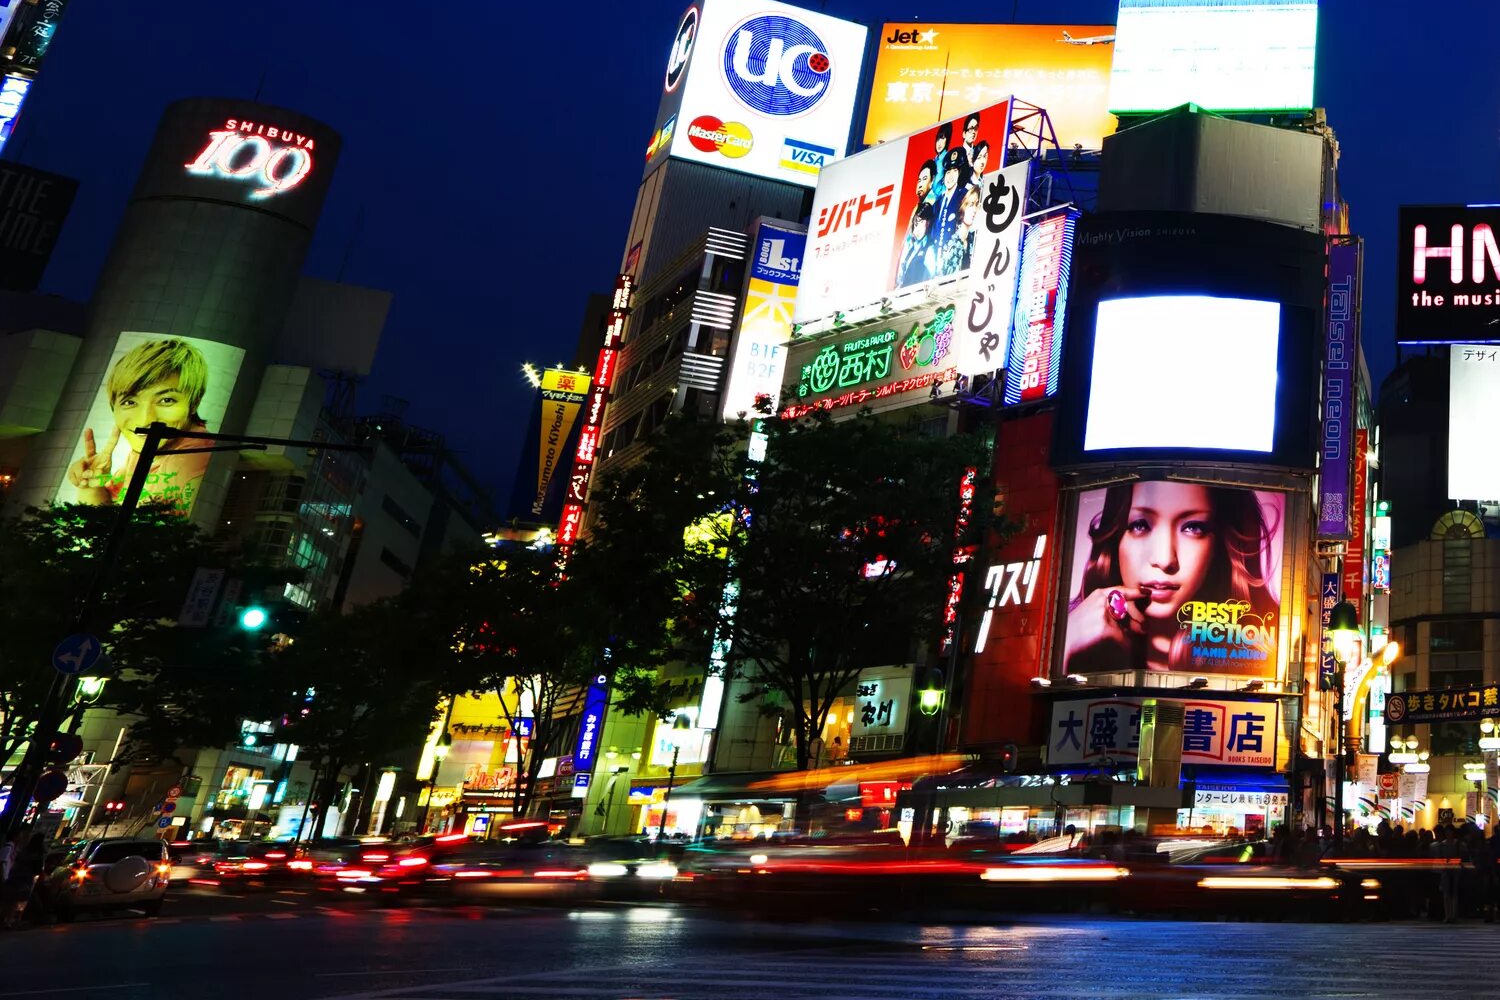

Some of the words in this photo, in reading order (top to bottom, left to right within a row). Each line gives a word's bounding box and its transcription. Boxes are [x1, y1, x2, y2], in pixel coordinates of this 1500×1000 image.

[20, 55, 38, 65] 7F
[226, 119, 314, 150] SHIBUYA
[688, 124, 753, 159] MasterCard
[184, 131, 312, 197] 109
[790, 148, 825, 167] VISA
[817, 183, 895, 239] シバトラ
[1116, 228, 1152, 242] Vision
[758, 239, 772, 264] BOOK
[968, 174, 1020, 363] もんじゃ
[1412, 290, 1444, 306] the
[1328, 275, 1352, 370] Taisei
[751, 342, 780, 359] B1F
[838, 346, 893, 388] 西村
[557, 375, 575, 391] 薬
[1324, 378, 1344, 460] neon
[1192, 601, 1244, 625] BEST
[1190, 621, 1276, 647] FICTION
[1227, 755, 1246, 764] BOOKS
